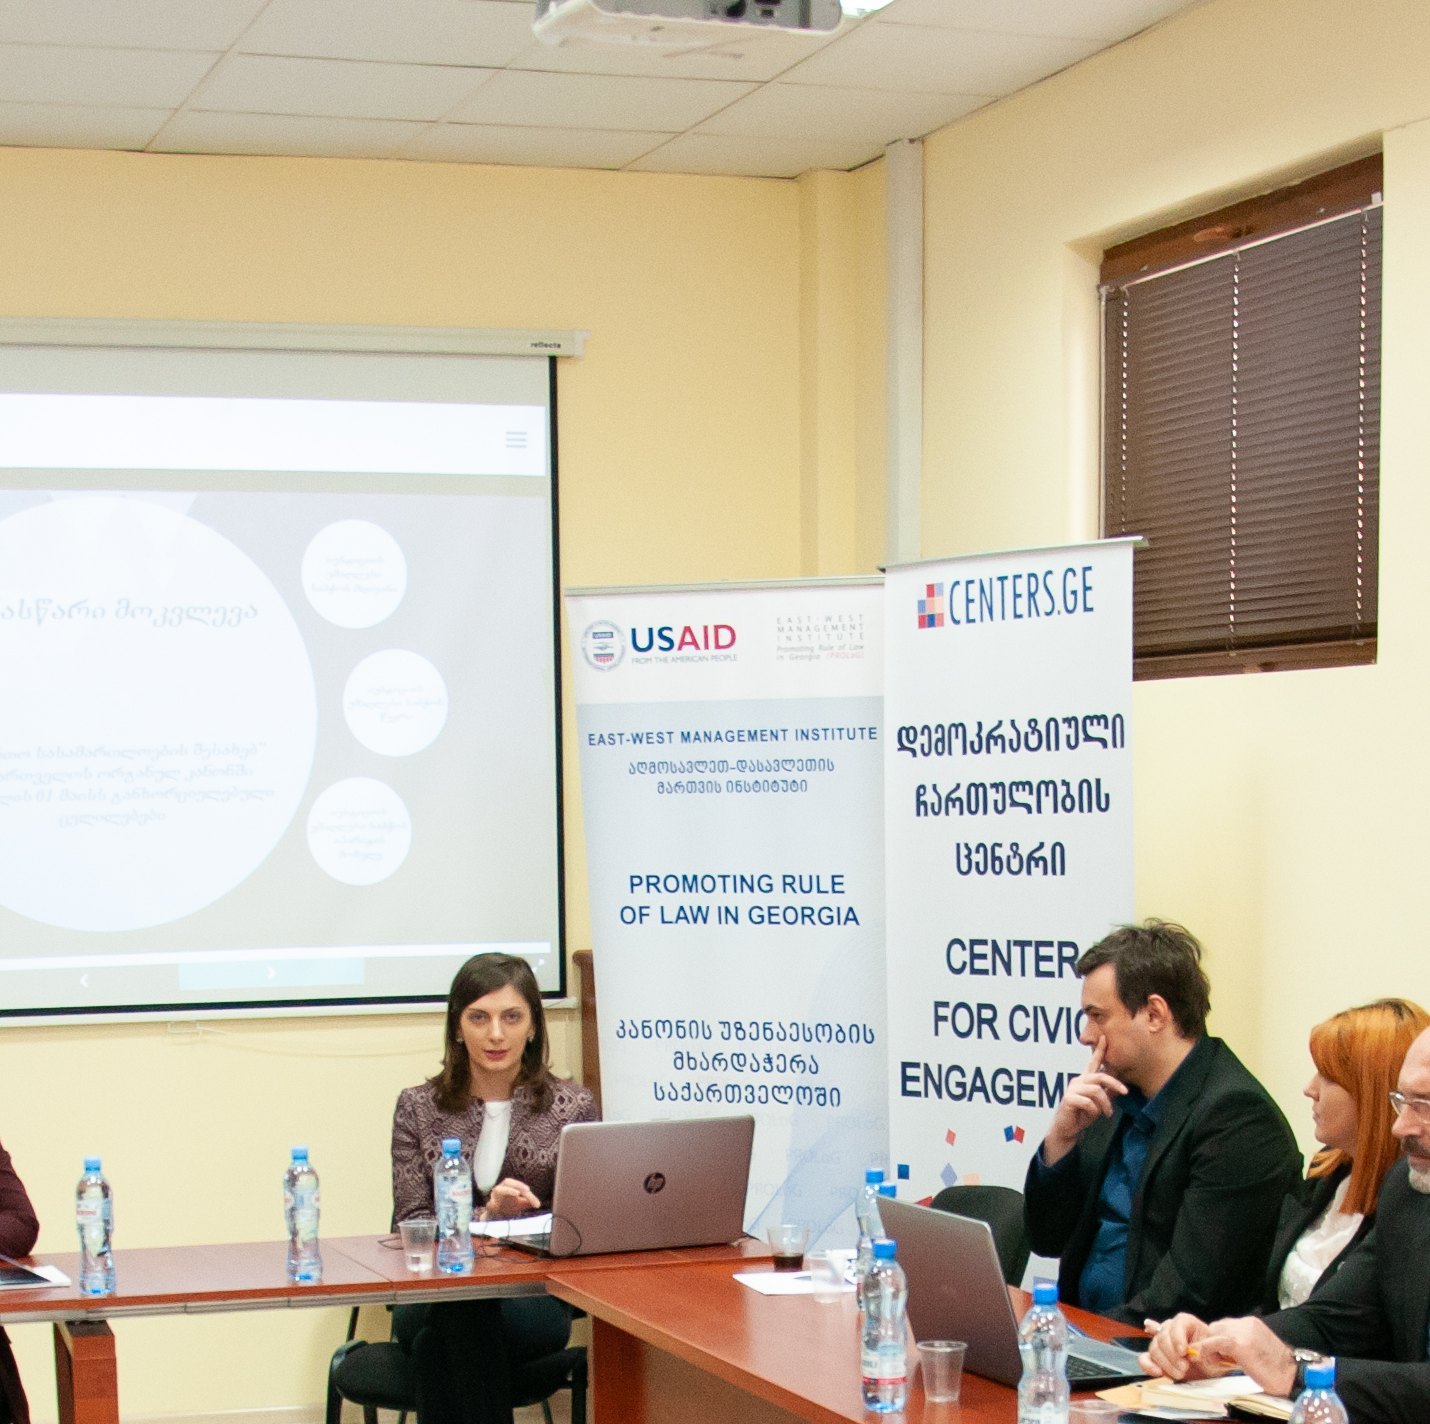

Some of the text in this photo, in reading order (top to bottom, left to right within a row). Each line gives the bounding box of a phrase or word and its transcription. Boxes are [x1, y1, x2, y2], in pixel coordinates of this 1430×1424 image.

[949, 565, 1094, 625] CENTERS.GE
[115, 597, 259, 628] მოკვლევა
[631, 624, 736, 653] USAID
[587, 726, 878, 747] EAST-WEST MANAGEMENT INSTITUTE
[897, 712, 1125, 758] დემოკრატიული
[657, 778, 808, 795] მართვის ინსტიტუტი
[915, 777, 1111, 817] ჩართულობის
[956, 841, 1066, 876] ცენტრი
[629, 873, 845, 894] PROMOTING RULE
[619, 905, 860, 926] OF LAW IN GEORGIA
[946, 937, 1083, 979] CENTER
[615, 1019, 876, 1045] კანონის უზენაესობის
[933, 1000, 1000, 1040] FOR
[673, 1050, 820, 1075] მხარდაჭერა
[653, 1081, 841, 1108] საქართველოში
